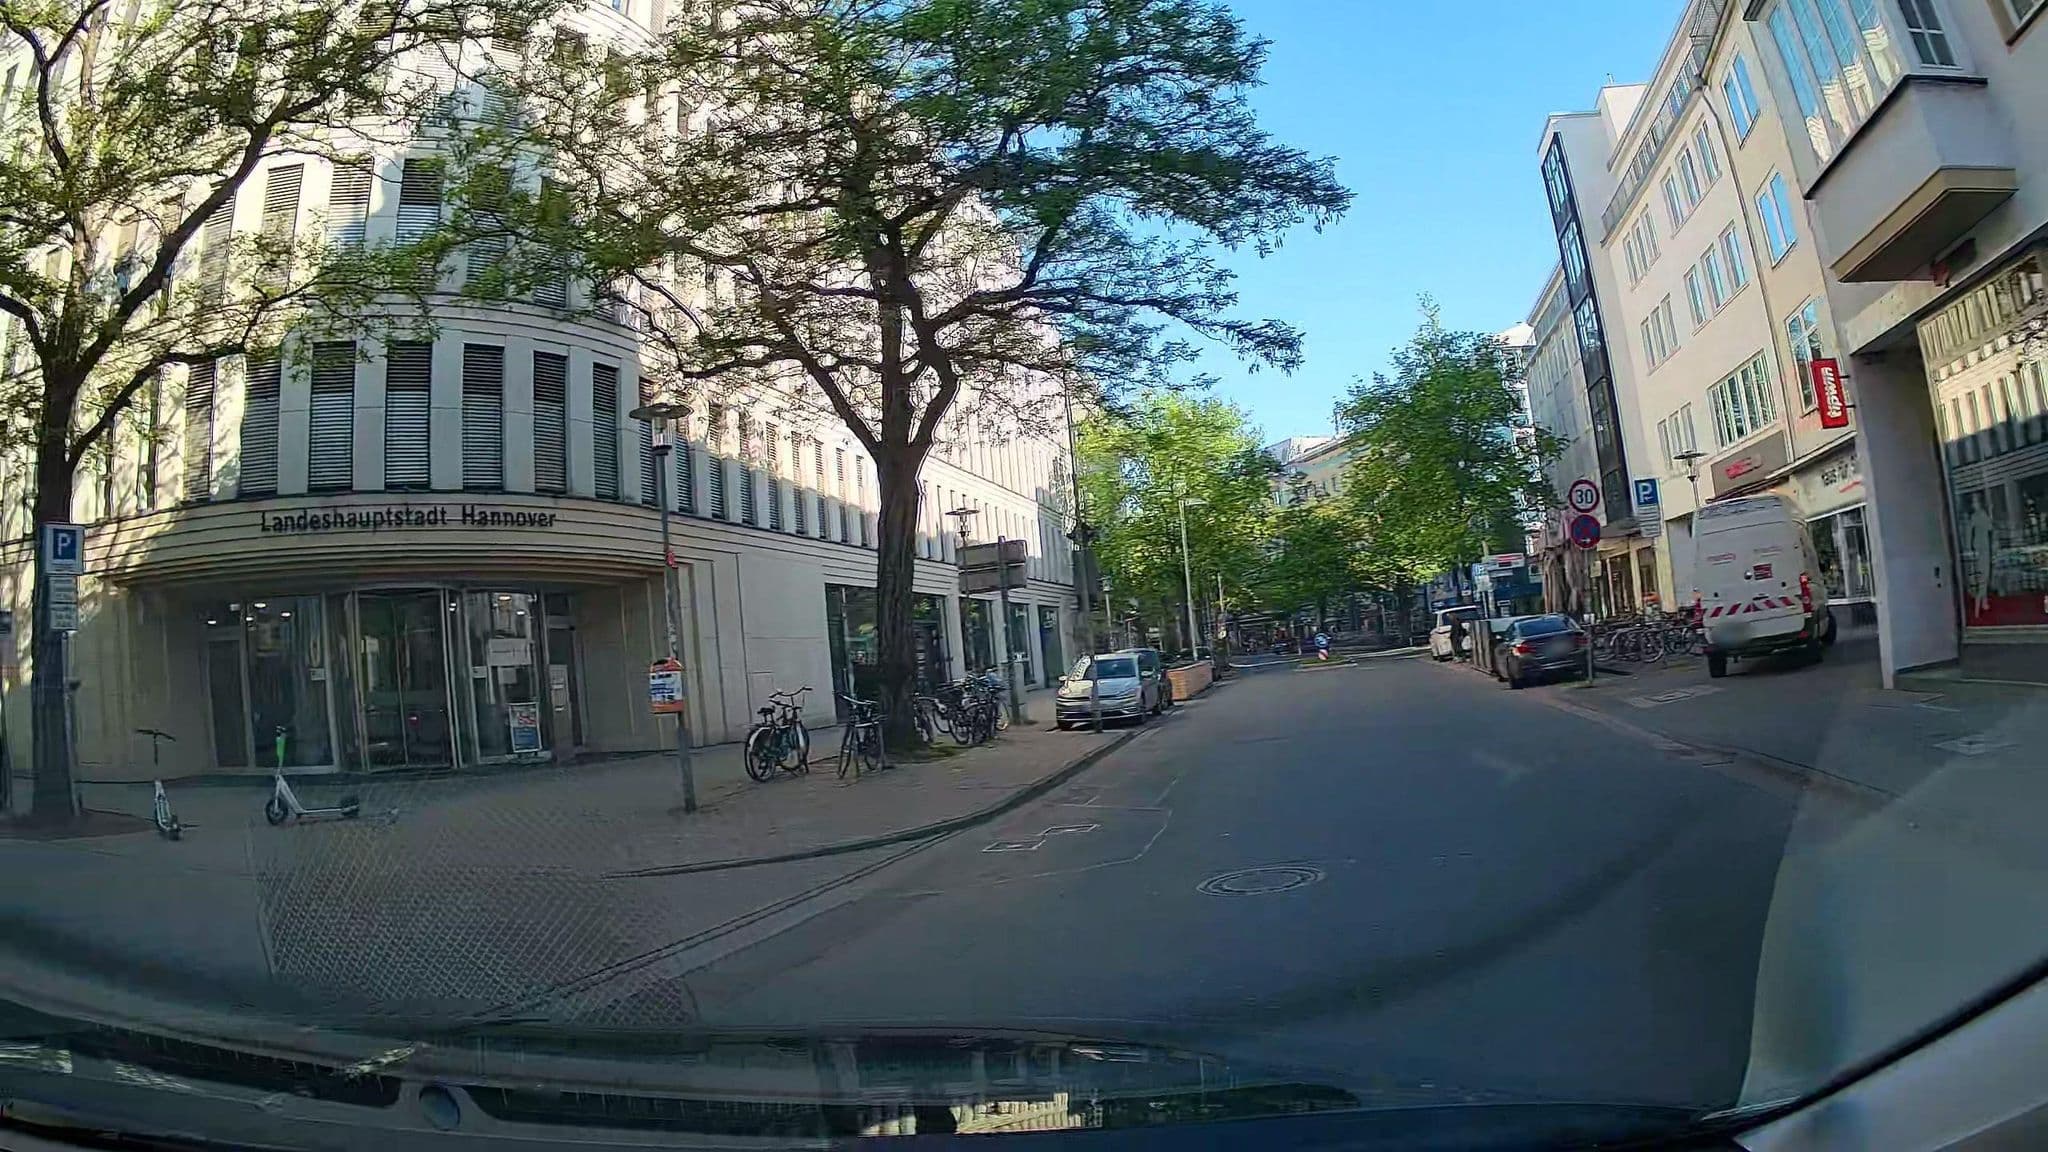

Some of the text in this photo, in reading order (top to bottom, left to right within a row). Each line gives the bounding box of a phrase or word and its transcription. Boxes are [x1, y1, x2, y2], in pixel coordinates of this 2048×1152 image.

[1821, 366, 1843, 418] tipwin
[1576, 488, 1594, 504] 30
[1638, 482, 1653, 503] P
[261, 504, 556, 533] Landeshauptstadt Hannover
[57, 533, 72, 556] P
